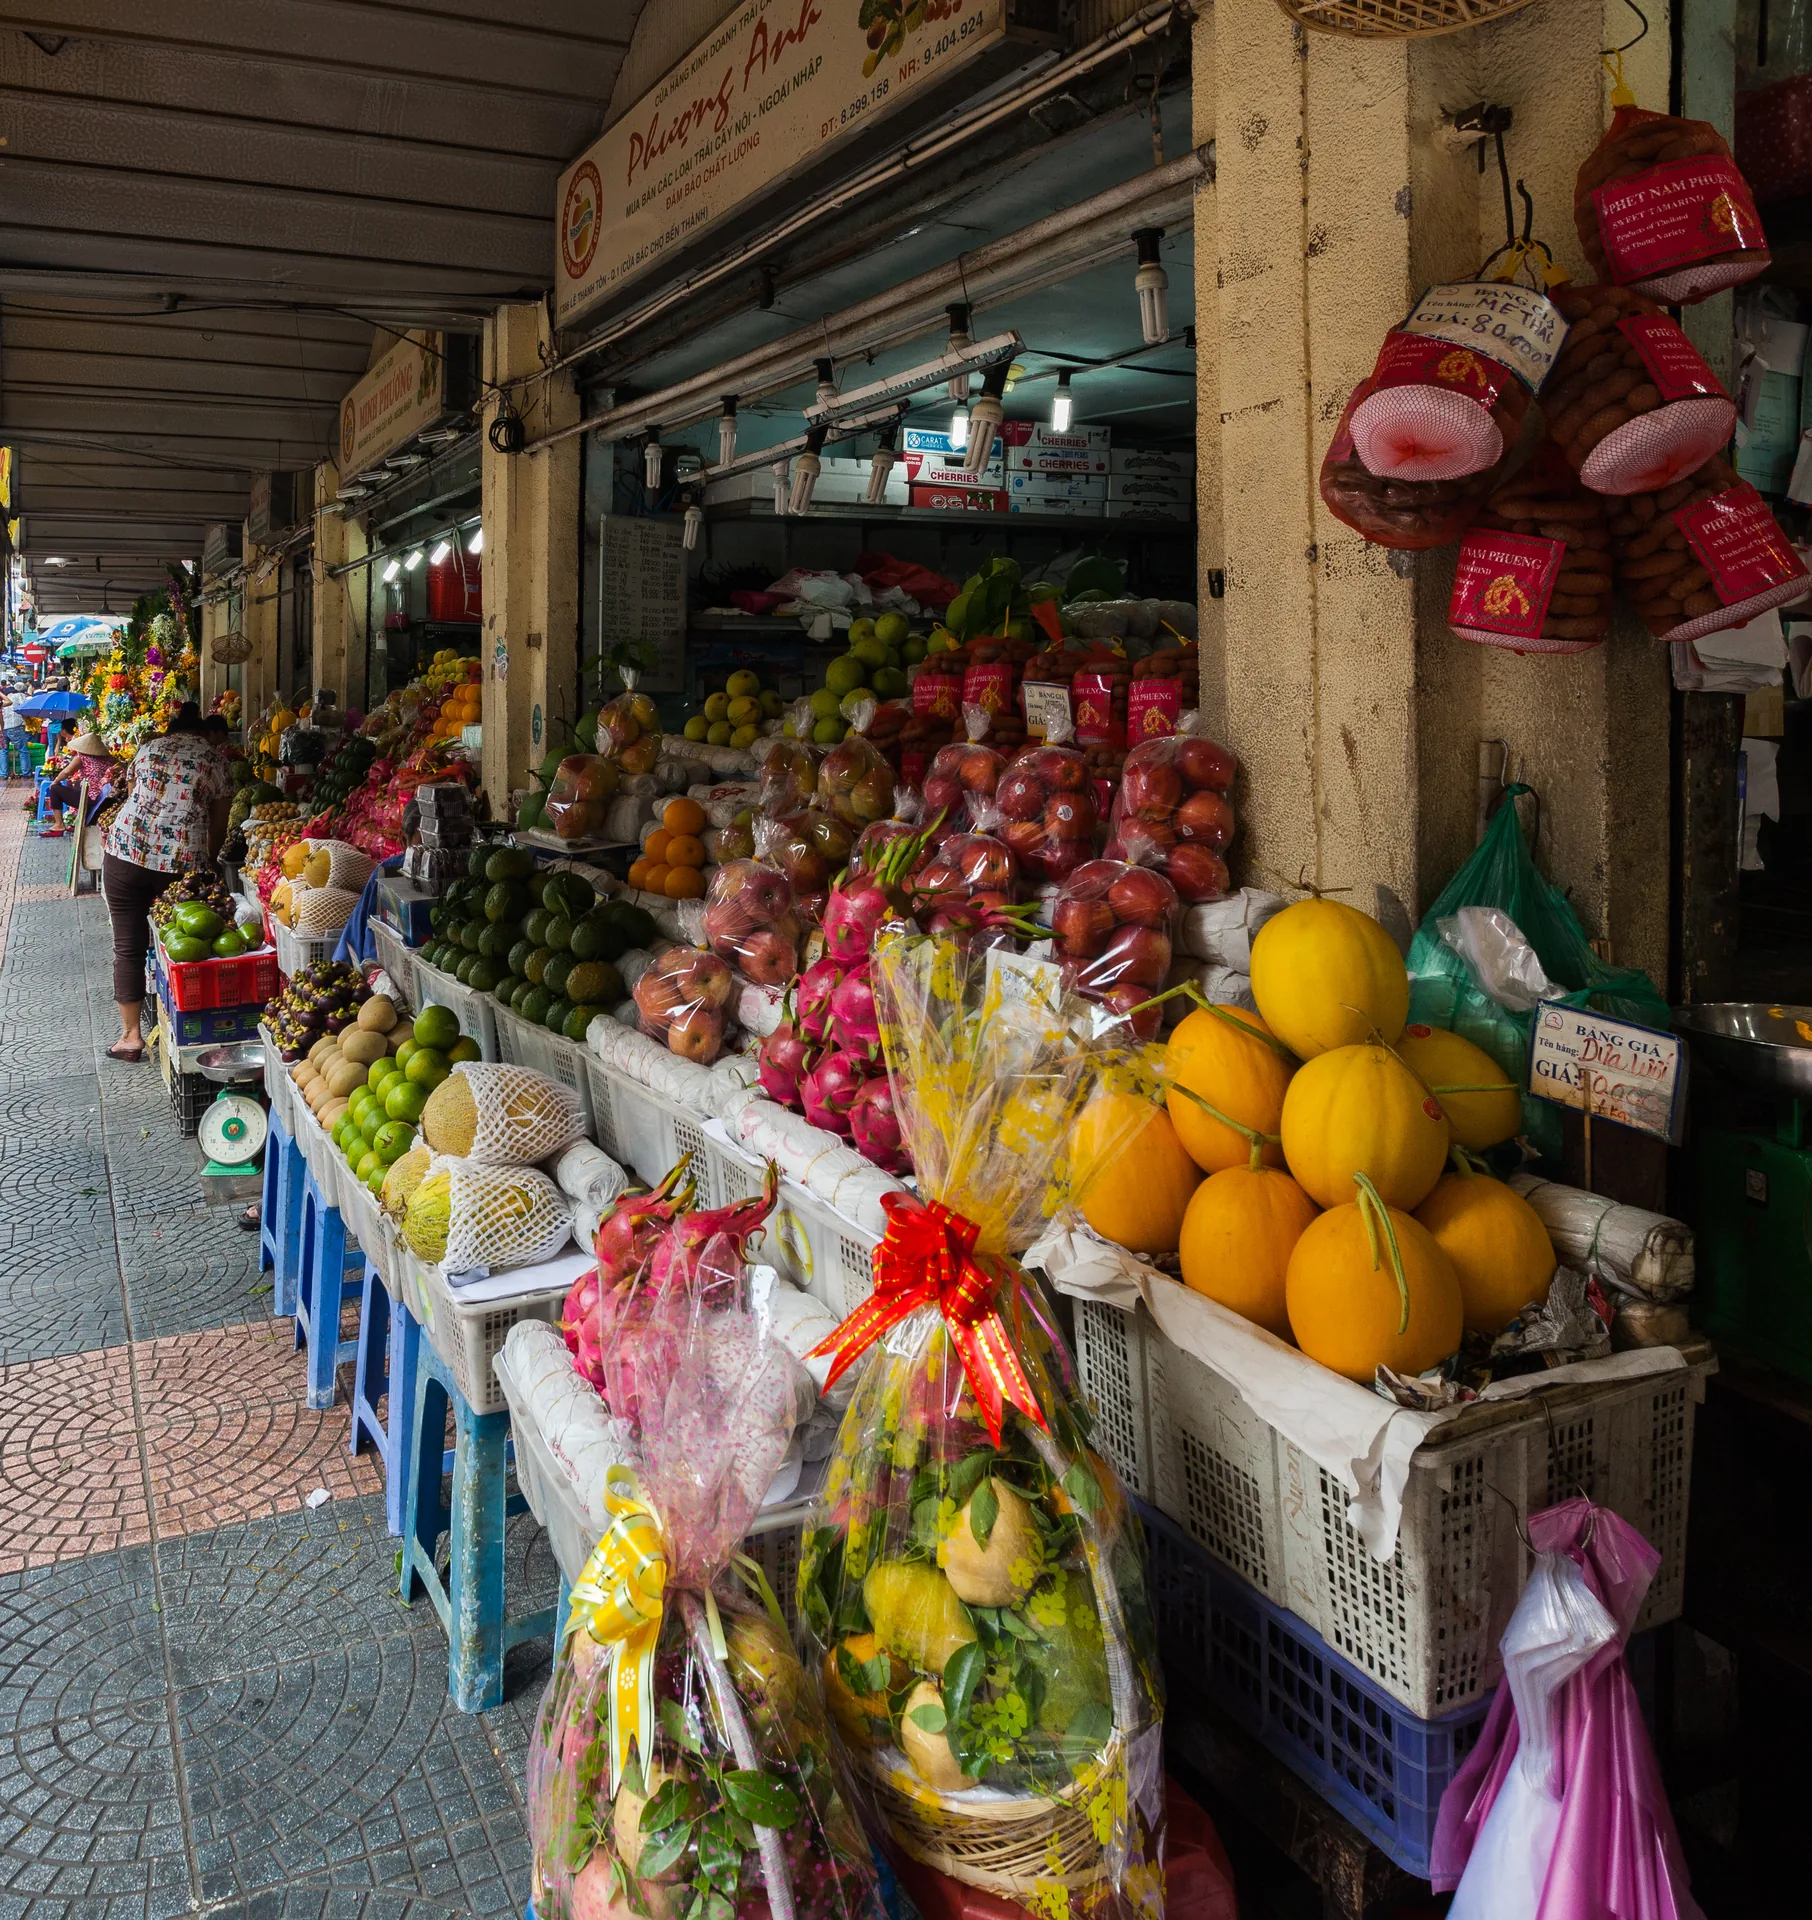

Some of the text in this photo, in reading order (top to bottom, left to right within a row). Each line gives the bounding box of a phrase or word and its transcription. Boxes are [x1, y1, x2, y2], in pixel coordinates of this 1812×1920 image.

[924, 10, 984, 65] 9.404.924
[669, 67, 690, 94] HÀNG
[691, 50, 708, 72] KINH
[710, 27, 737, 58] DOANH
[628, 0, 822, 187] Phượng Anh
[821, 78, 889, 139] ĐT: 8.299.158
[625, 203, 640, 218] MUA
[657, 173, 673, 194] CÁC
[675, 159, 692, 181] LOẠI
[695, 143, 713, 165] TRÁI
[715, 126, 733, 151] CÂY
[735, 114, 751, 136] NỘI
[793, 56, 822, 91] NHẬP
[1609, 190, 1646, 214] PHET
[1649, 179, 1687, 199] NAM
[1612, 194, 1705, 230] SWEET TAMARIND
[1616, 212, 1689, 243] Products of Thailand
[1656, 227, 1687, 241] Variety
[1416, 312, 1470, 326] GIÁ:
[920, 436, 943, 444] CARAT
[1041, 437, 1087, 448] CHERRIES
[1039, 459, 1090, 470] CHERRIES
[930, 472, 979, 483] CHERRIES
[1701, 511, 1738, 535] PHET
[1712, 531, 1741, 549] SWEET
[1488, 550, 1542, 570] PHUENG
[1140, 692, 1172, 701] PHUENG
[1538, 1036, 1556, 1048] Tên
[1556, 1041, 1580, 1058] hàng:
[1575, 1024, 1661, 1058] BẢNG GIÁ
[1535, 1059, 1580, 1087] GIÁ:
